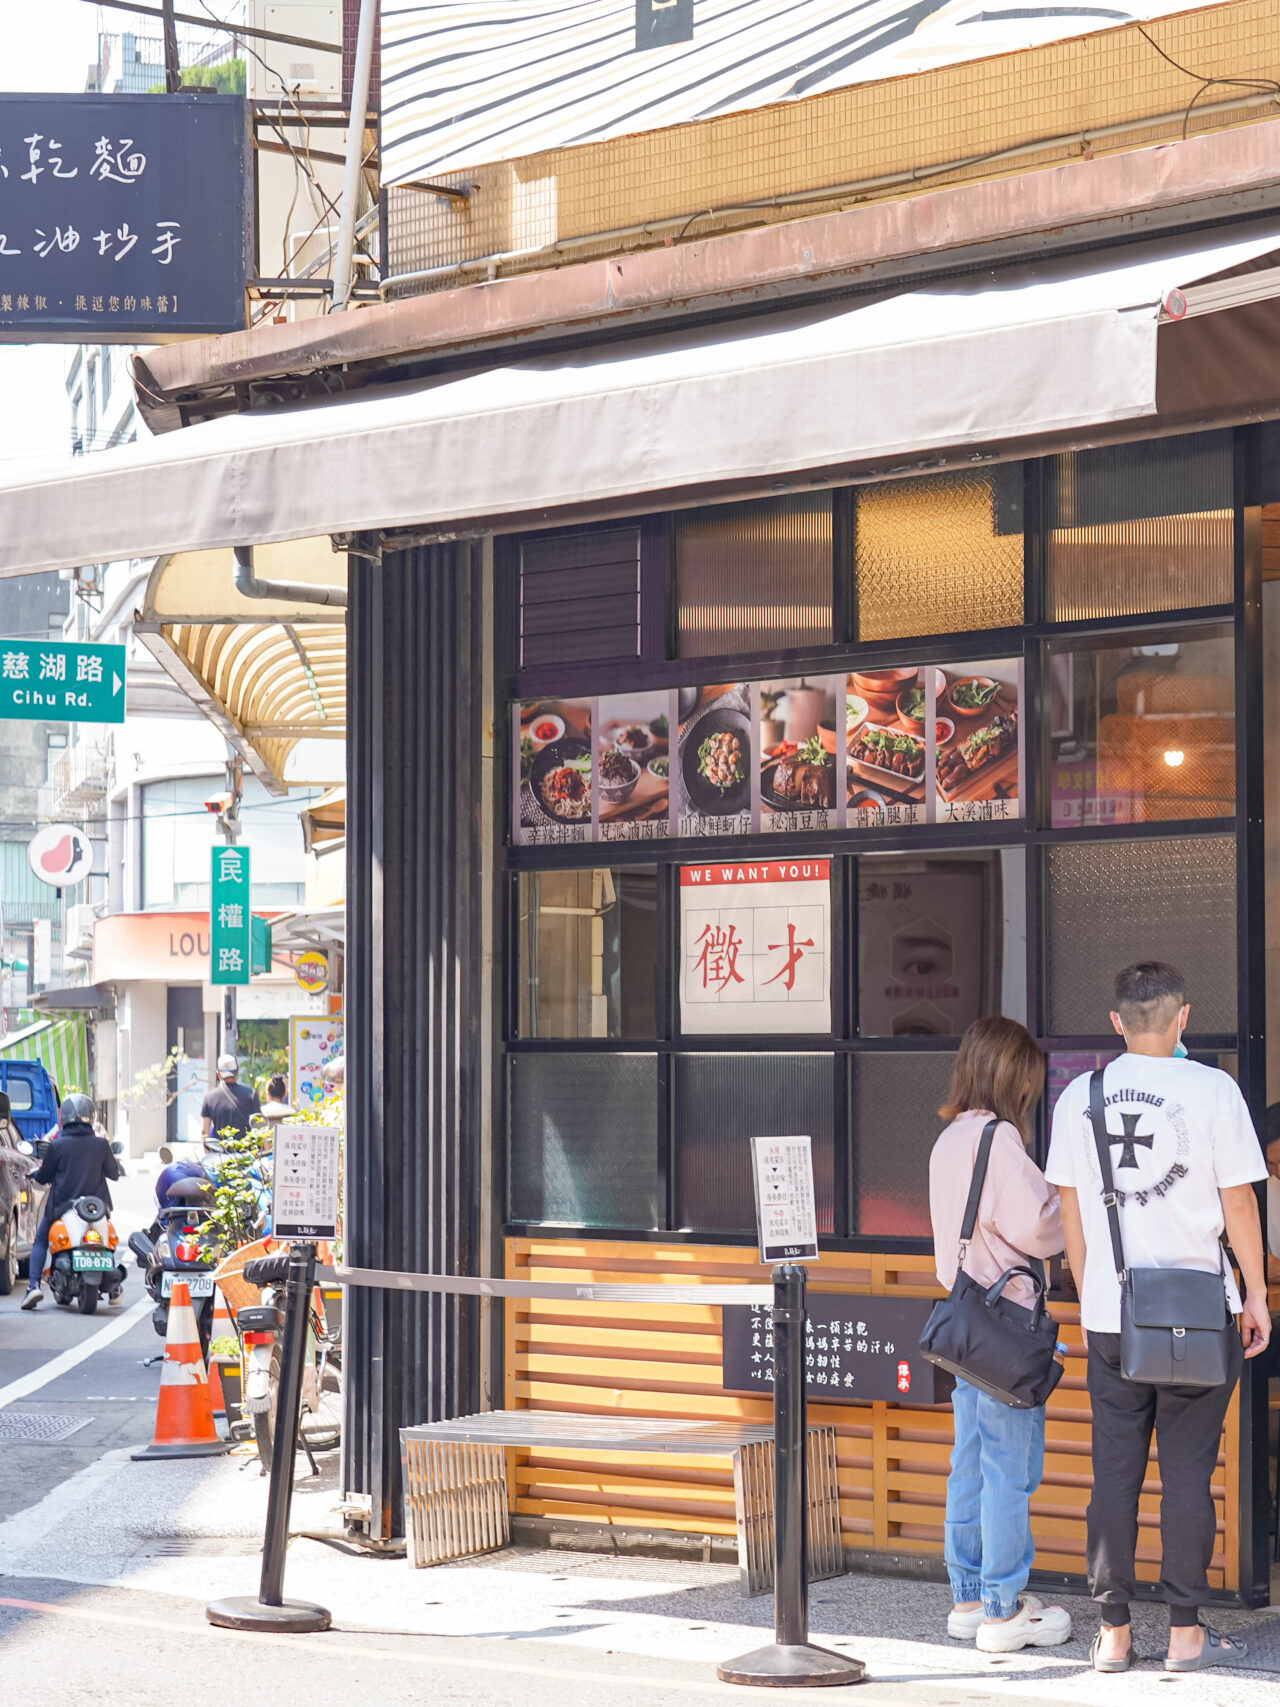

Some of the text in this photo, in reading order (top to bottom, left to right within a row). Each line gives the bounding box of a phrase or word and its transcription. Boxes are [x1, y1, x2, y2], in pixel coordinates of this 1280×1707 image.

[0, 132, 147, 184] 乾麵
[2, 653, 103, 683] 慈湖路
[13, 690, 92, 707] Cihu Rd.
[690, 864, 820, 882] WE WANT YOU!
[218, 859, 243, 972] 民權路
[692, 923, 815, 994] 徵才
